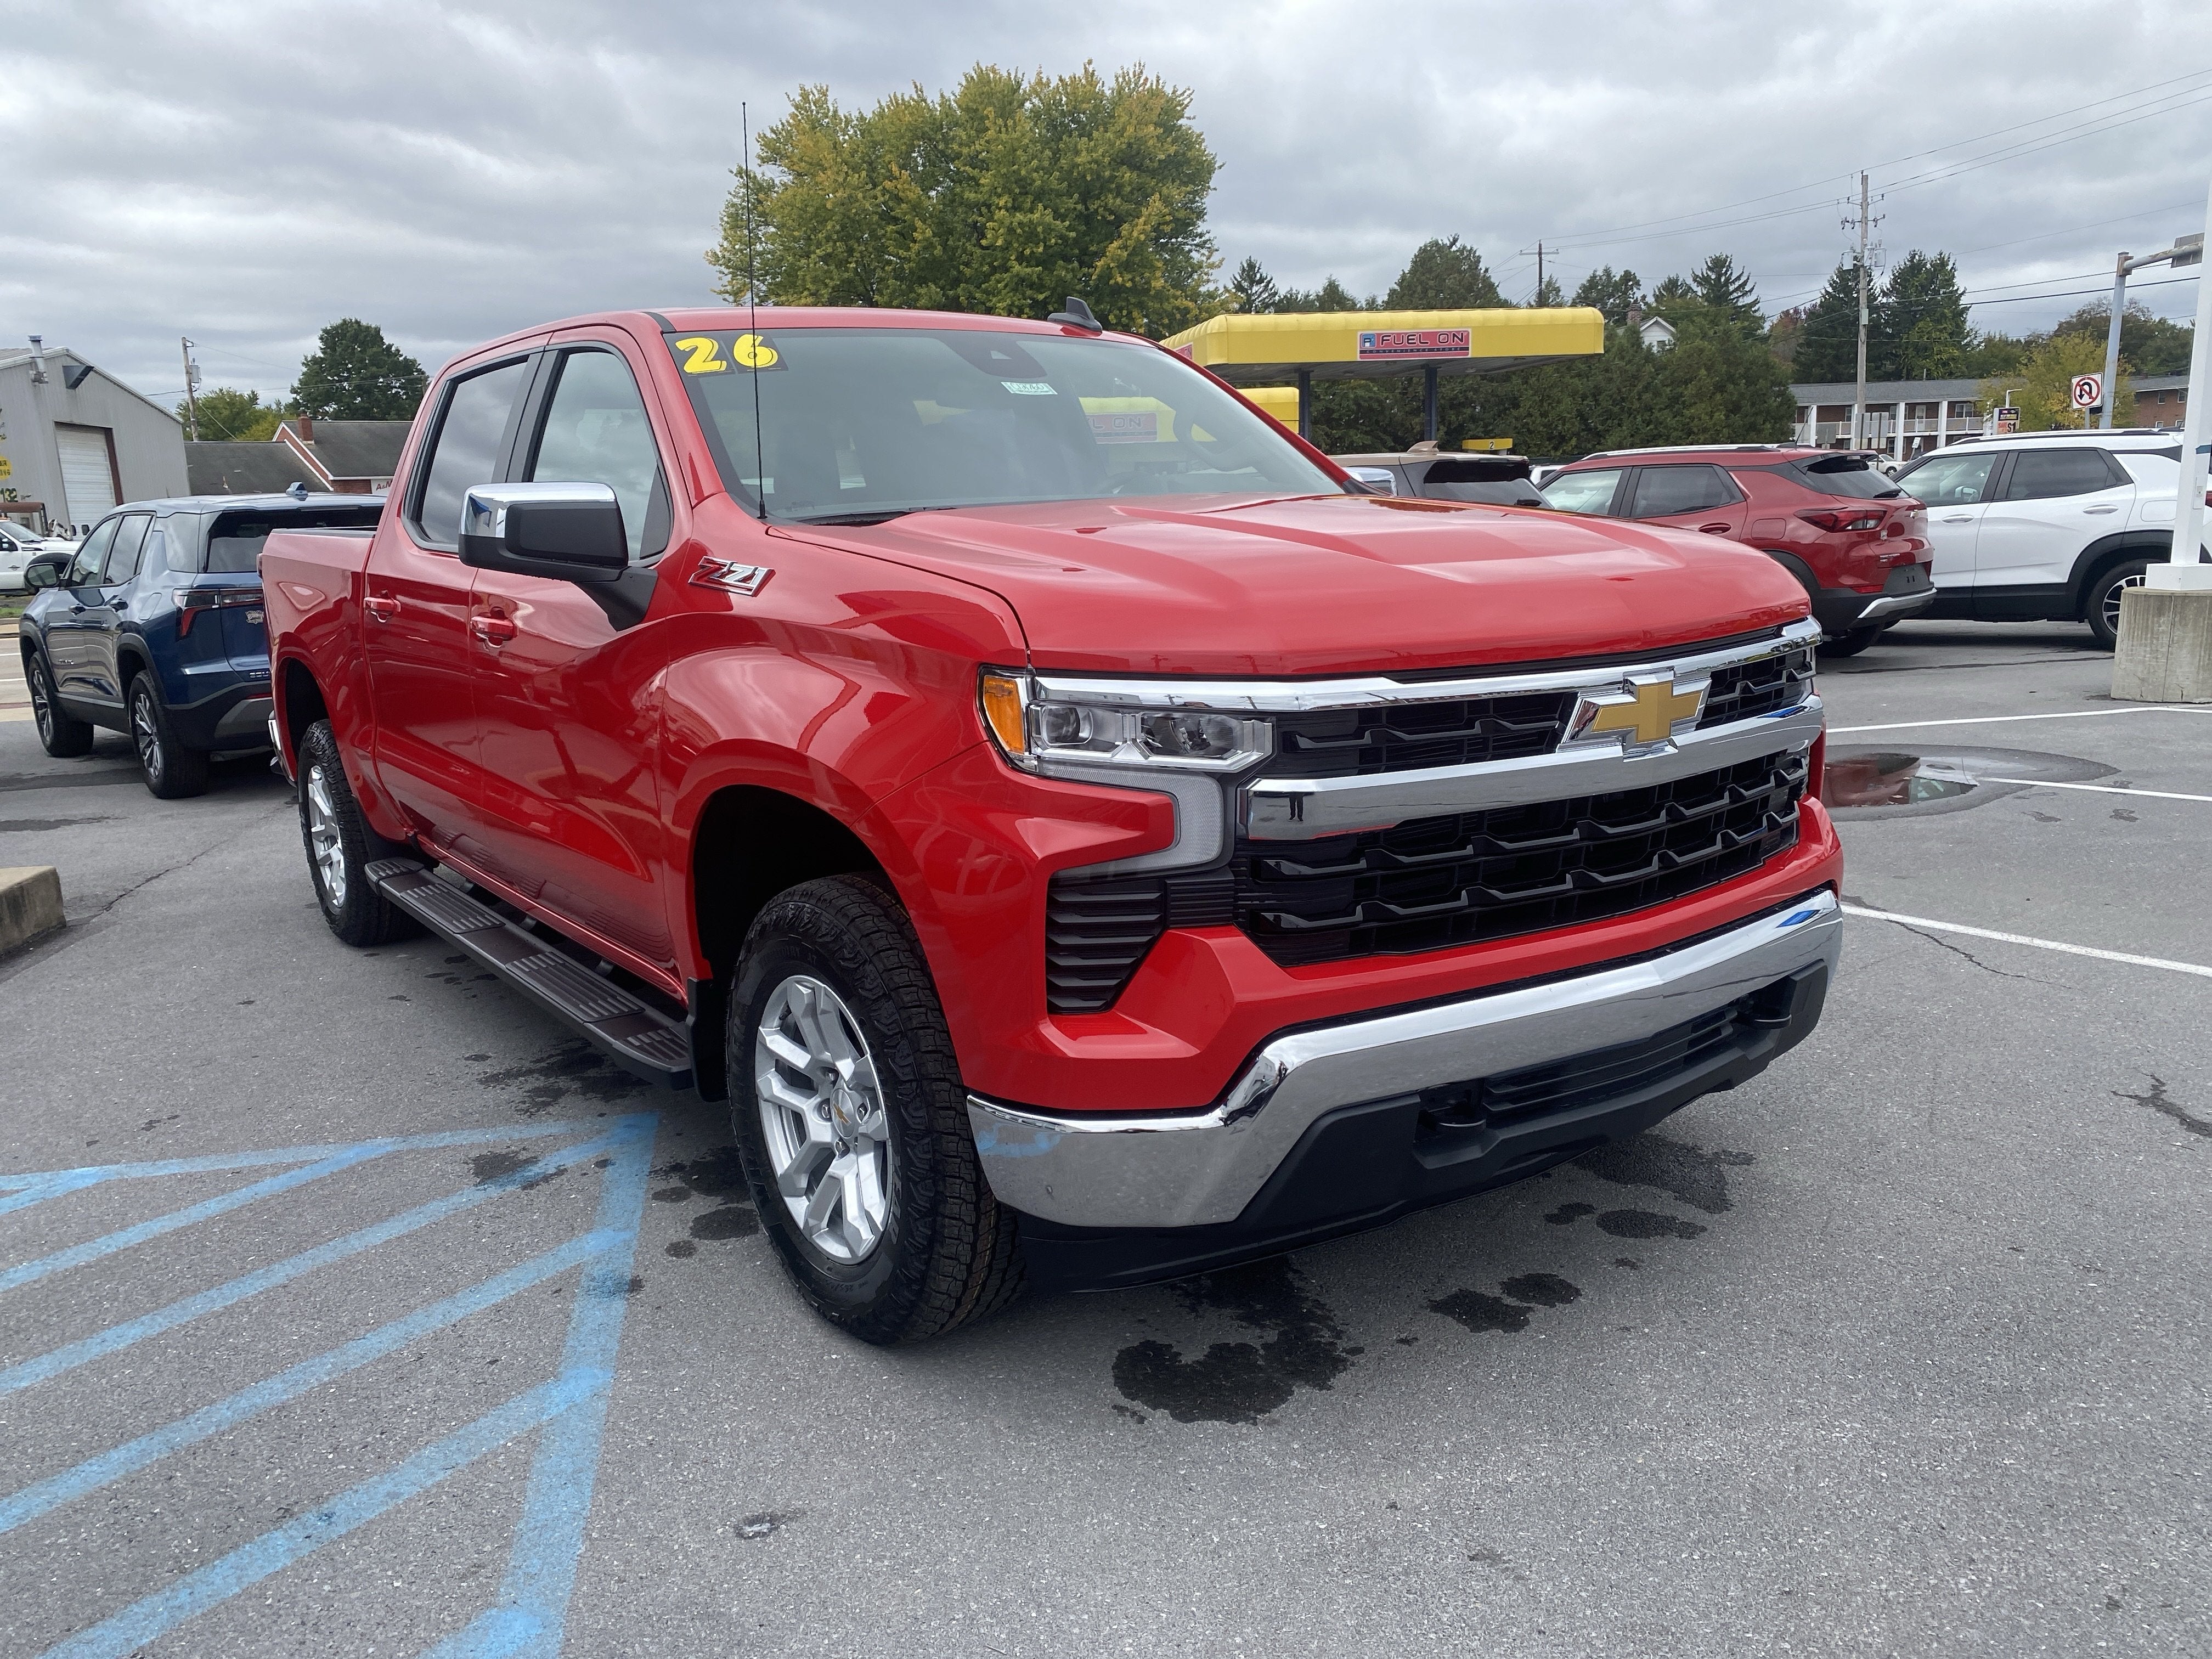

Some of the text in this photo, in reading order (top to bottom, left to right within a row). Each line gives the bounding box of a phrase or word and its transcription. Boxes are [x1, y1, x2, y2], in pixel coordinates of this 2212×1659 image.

[1380, 332, 1464, 346] FUEL ON
[675, 334, 778, 374] 26
[1114, 417, 1142, 428] ON
[1489, 441, 1494, 450] 2
[688, 556, 776, 598] Z71
